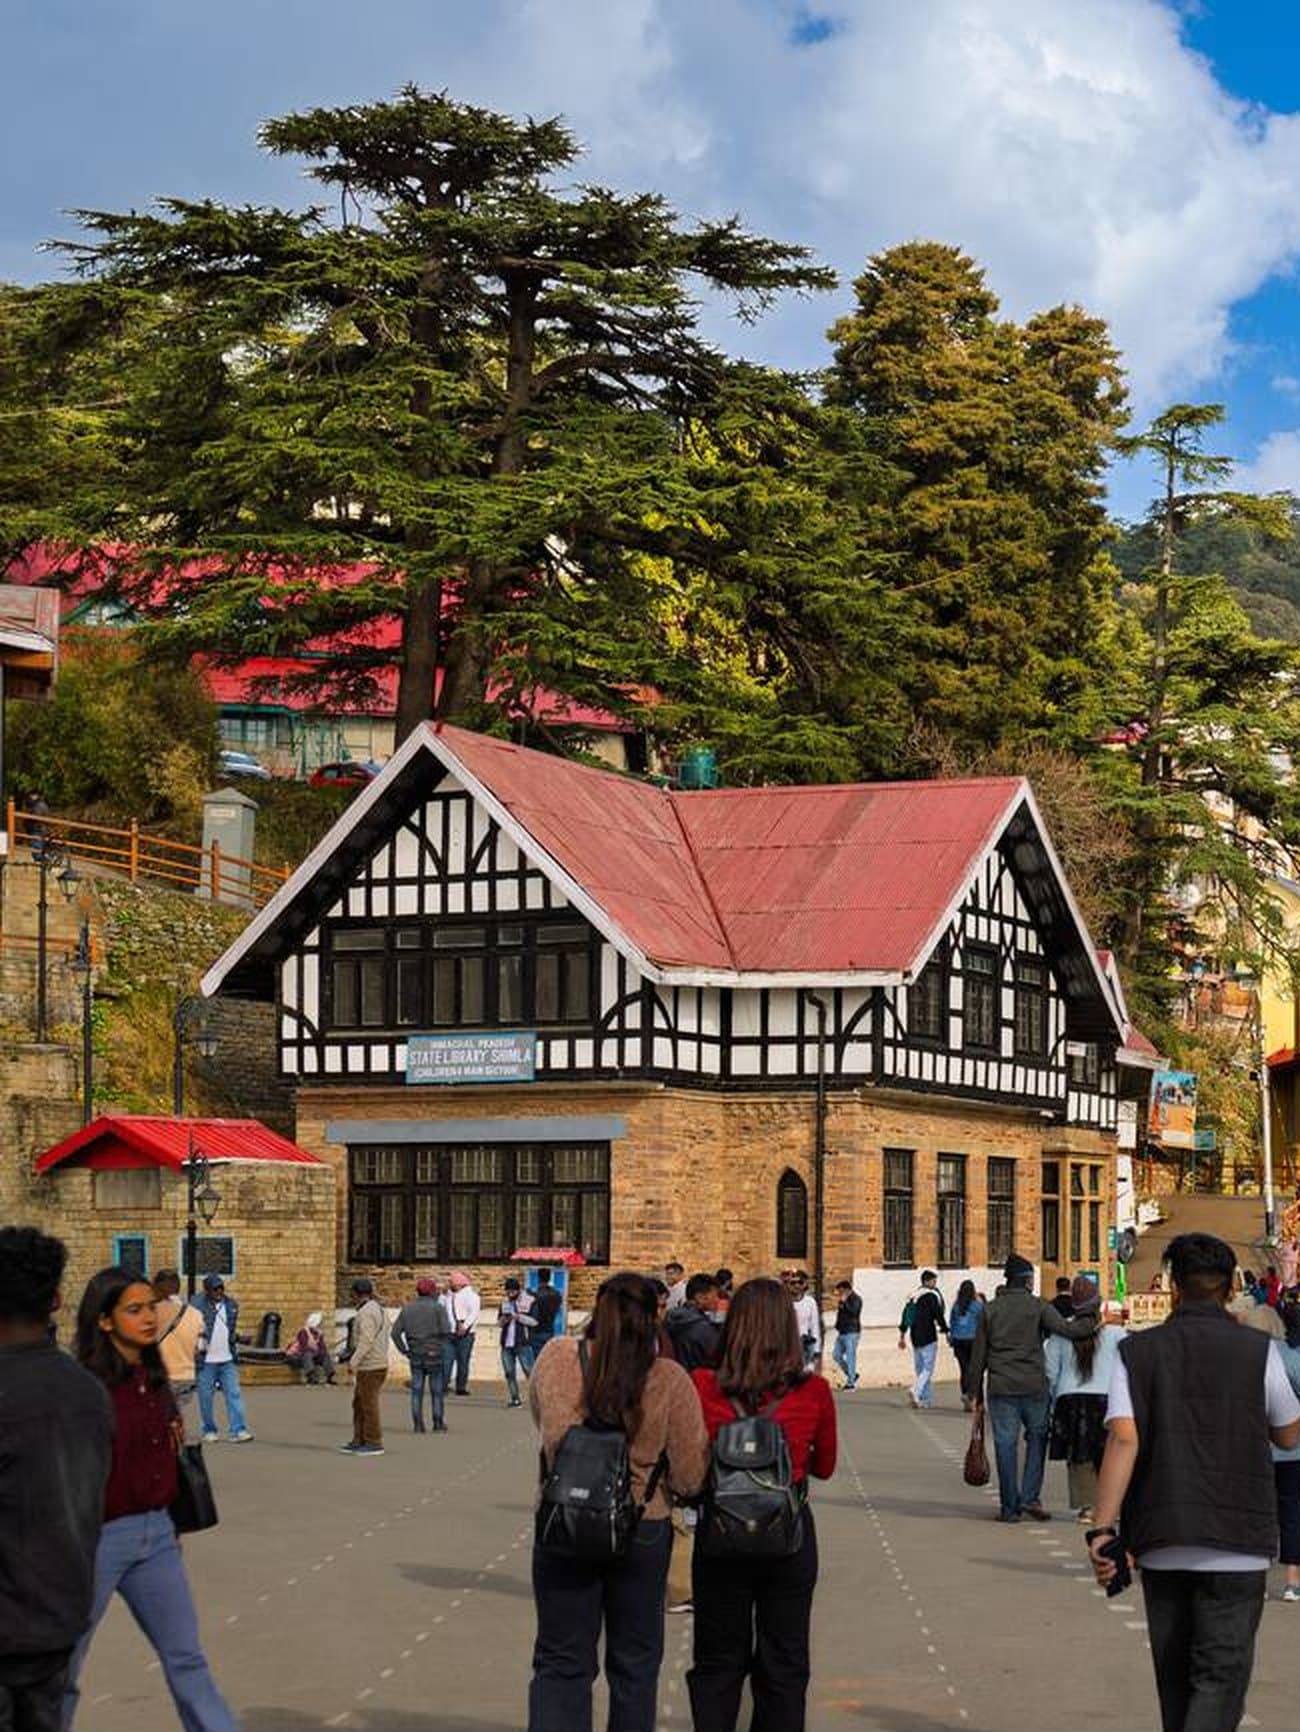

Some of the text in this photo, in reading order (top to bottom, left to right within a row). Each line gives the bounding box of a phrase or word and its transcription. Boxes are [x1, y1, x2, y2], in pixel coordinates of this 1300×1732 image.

[409, 1048, 532, 1065] STATE LIBRARY SHIMLA
